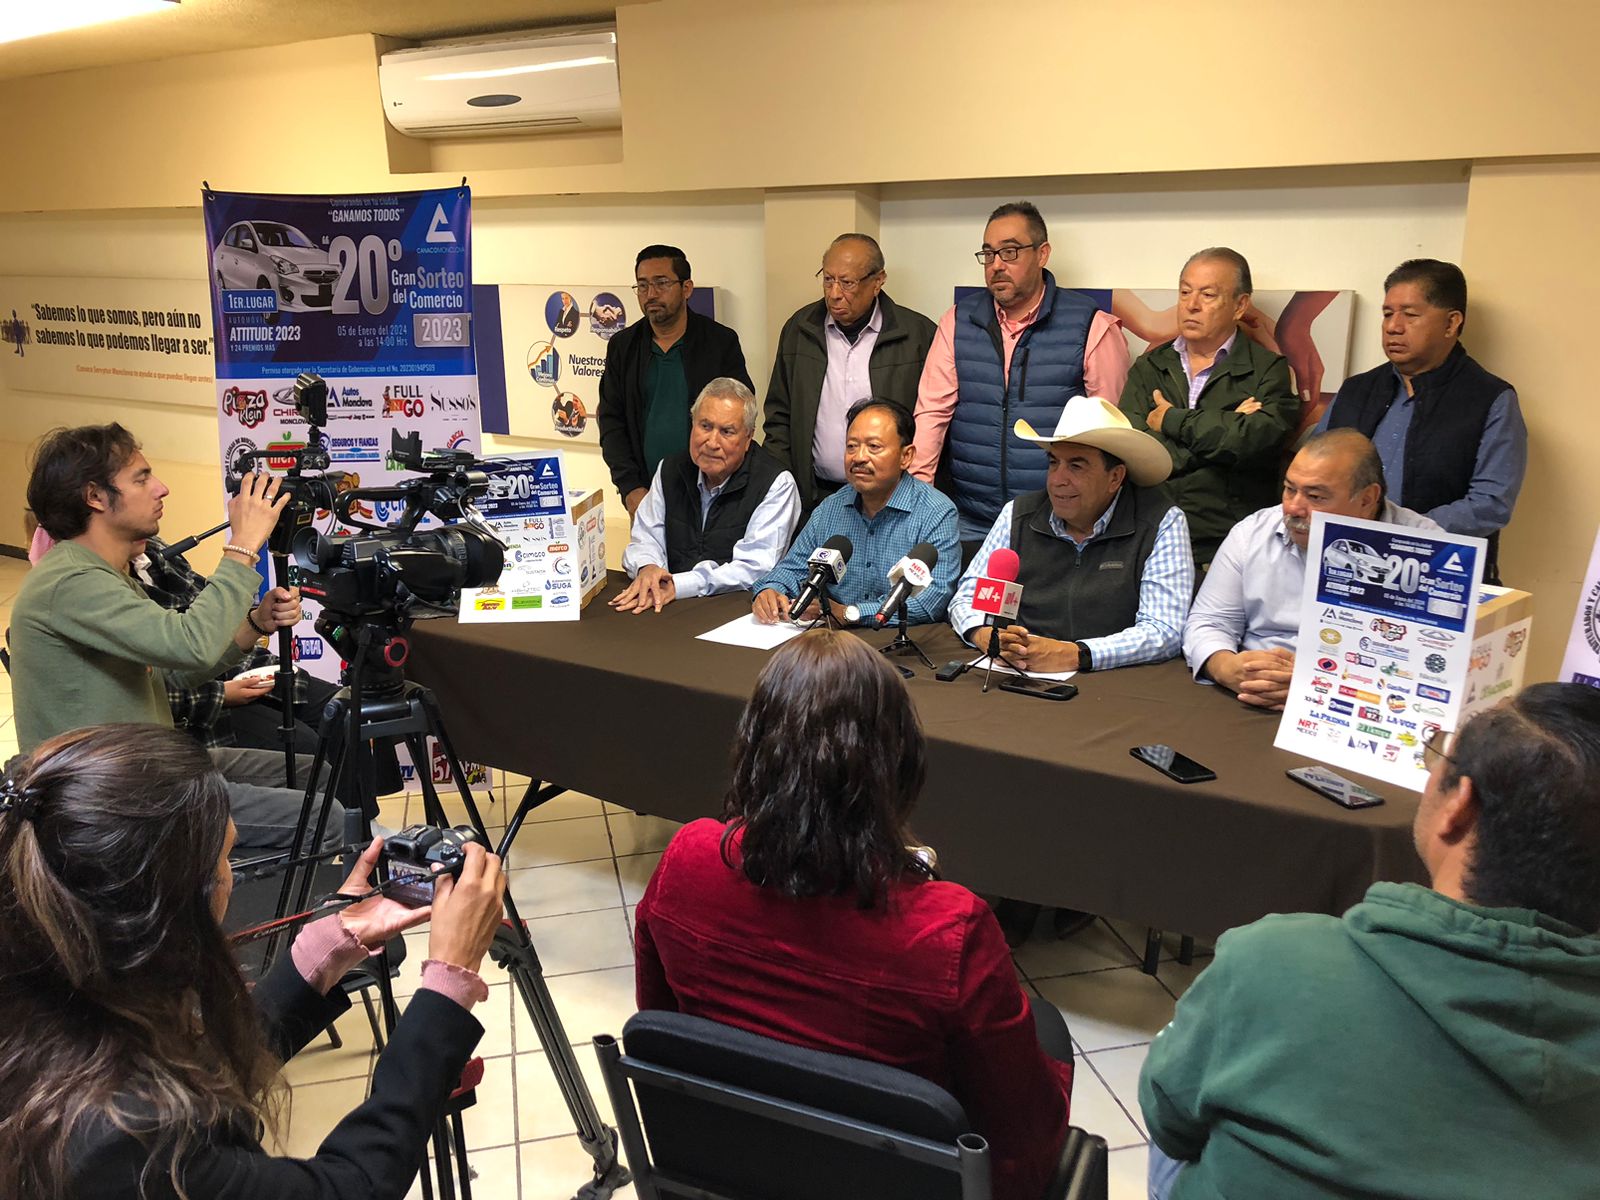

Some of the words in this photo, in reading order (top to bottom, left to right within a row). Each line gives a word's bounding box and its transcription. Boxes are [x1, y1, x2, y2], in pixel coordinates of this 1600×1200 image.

[392, 269, 416, 286] Gran
[417, 266, 464, 289] Sorteo
[393, 289, 407, 304] del
[410, 291, 463, 309] Comercio
[77, 305, 87, 323] lo
[88, 309, 106, 326] que
[107, 309, 142, 328] somos,
[142, 311, 165, 329] pero
[167, 309, 187, 329] aún
[188, 313, 201, 329] no
[230, 327, 274, 342] ATTITUDE
[275, 326, 301, 341] 2023
[338, 326, 347, 336] 05
[348, 326, 356, 336] de
[358, 326, 376, 336] Enero
[378, 326, 389, 336] del
[390, 325, 408, 336] 2024
[422, 318, 462, 342] 2023
[36, 329, 76, 346] sabemos
[77, 330, 85, 347] lo
[87, 334, 105, 350] que
[106, 333, 150, 351] podemos
[151, 334, 181, 355] llegar
[182, 340, 190, 354] a
[242, 344, 264, 352] PREMIOS
[365, 337, 375, 347] las
[396, 336, 409, 347] Hrs
[569, 354, 607, 367] Nuestros
[573, 365, 605, 377] Valores
[342, 387, 360, 397] Autos
[394, 385, 424, 398] FULL
[342, 397, 373, 408] Monclova
[403, 399, 425, 418] GO
[274, 409, 300, 417] CHIR
[301, 640, 322, 656] TOTAL
[1400, 719, 1417, 730] VOZ
